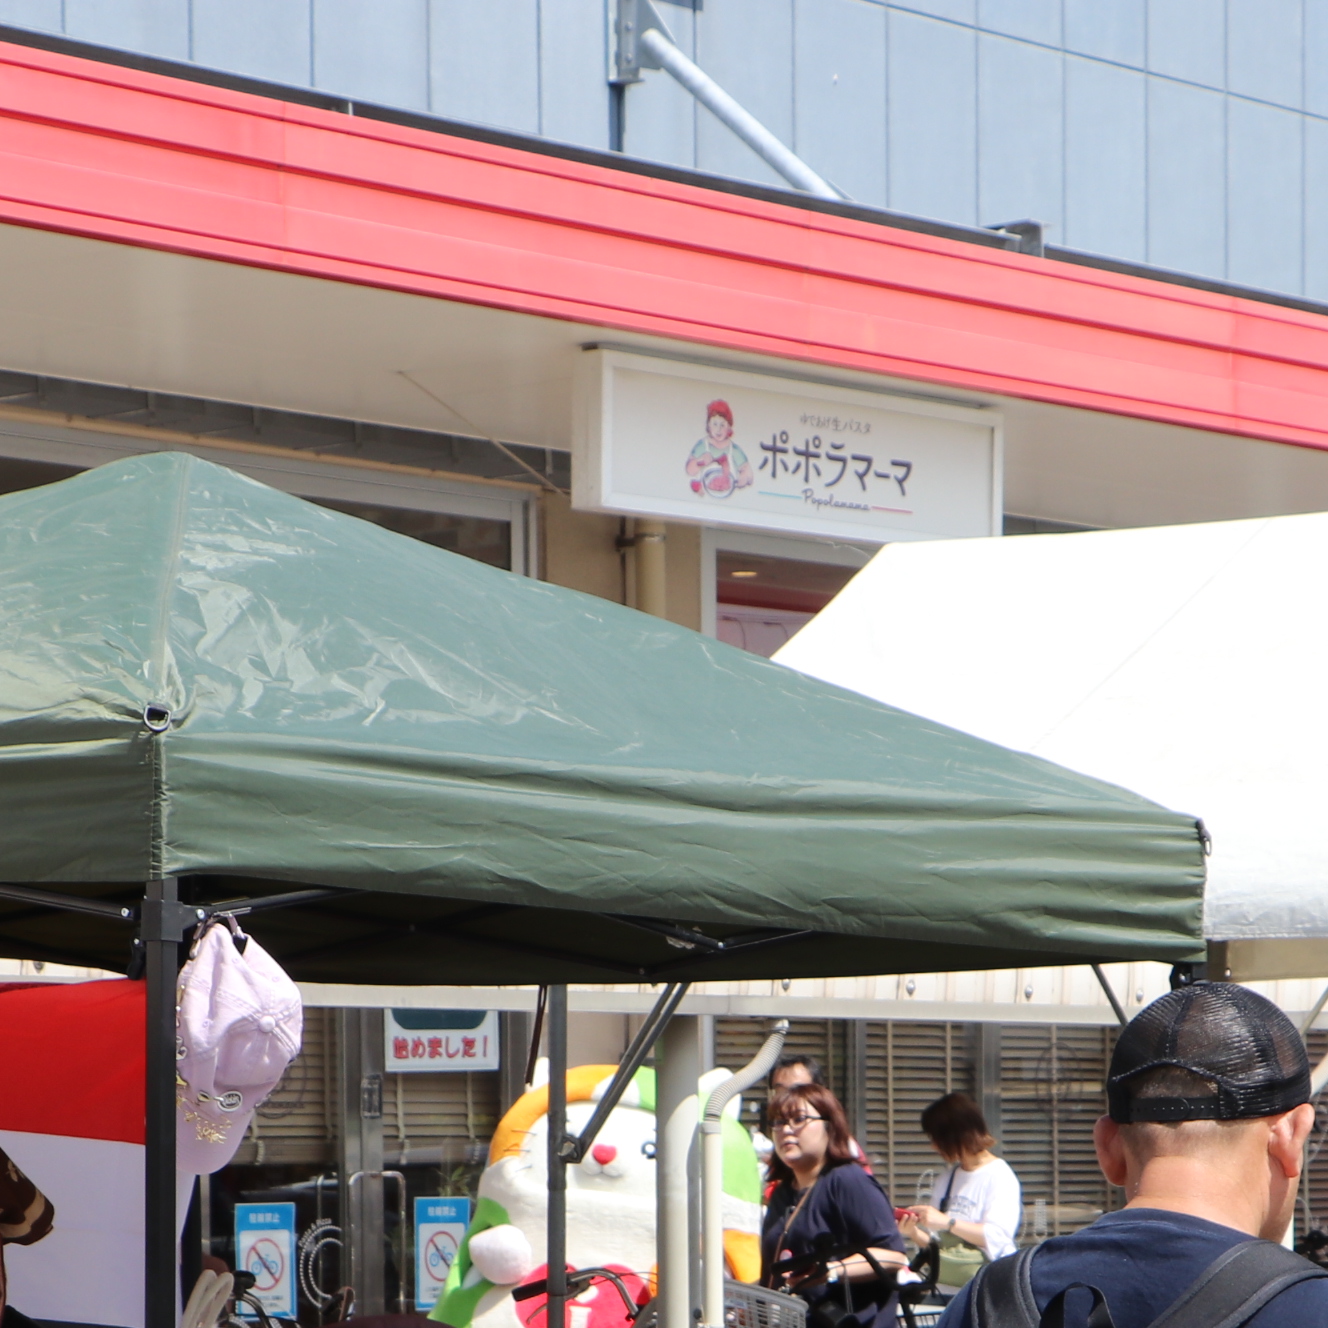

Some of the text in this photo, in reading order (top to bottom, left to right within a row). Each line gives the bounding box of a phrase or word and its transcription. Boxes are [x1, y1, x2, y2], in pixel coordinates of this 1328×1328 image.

[758, 430, 913, 497] ポポラマーマ
[802, 488, 871, 511] Popolamama
